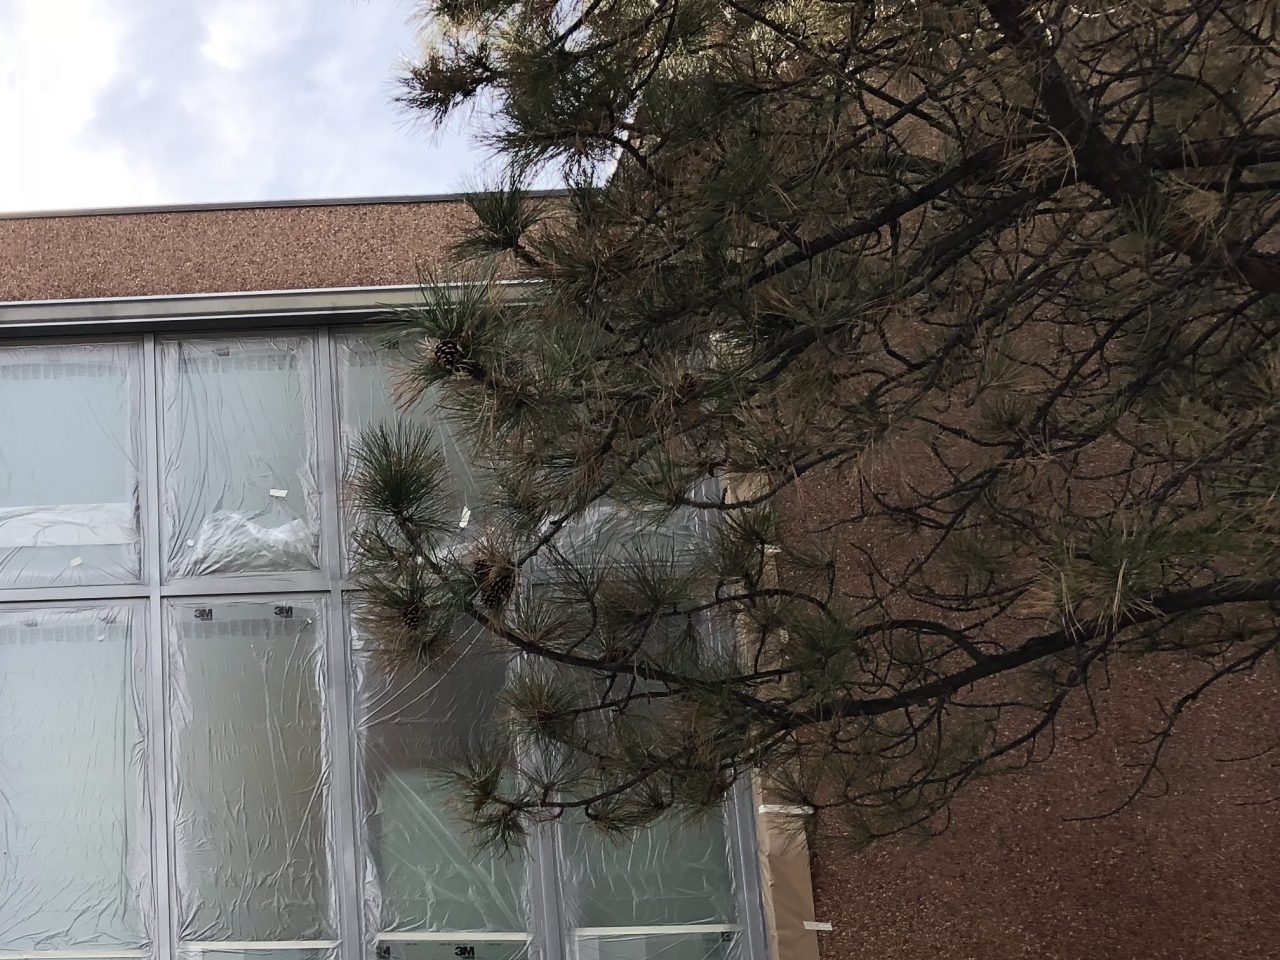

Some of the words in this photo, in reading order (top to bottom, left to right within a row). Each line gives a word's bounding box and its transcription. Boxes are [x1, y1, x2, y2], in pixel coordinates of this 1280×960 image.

[194, 608, 213, 618] 3M
[274, 606, 293, 616] 3M
[454, 946, 475, 956] 3M
